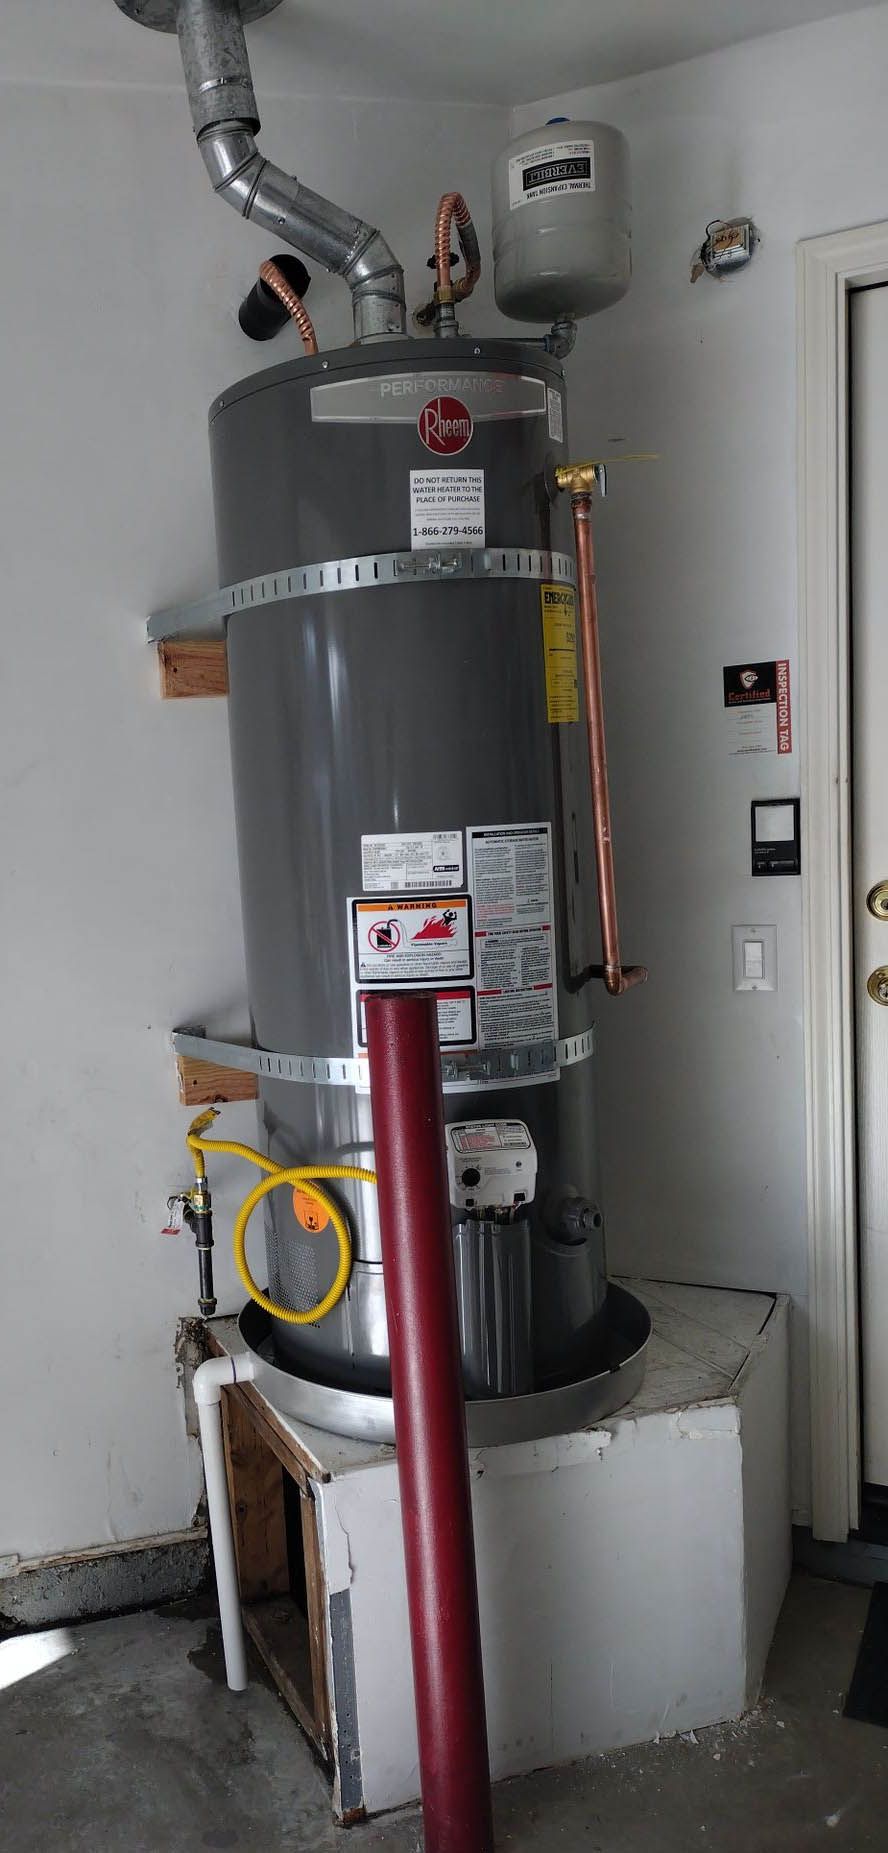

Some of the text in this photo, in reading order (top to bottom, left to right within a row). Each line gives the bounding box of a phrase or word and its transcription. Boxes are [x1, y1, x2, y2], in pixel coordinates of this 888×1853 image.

[528, 163, 585, 183] EVERBILT
[540, 184, 568, 195] EXPANSION
[380, 377, 504, 397] PERFORMANCE
[424, 399, 470, 446] Rheem
[441, 476, 467, 484] RETURN
[447, 495, 481, 503] PURCHASE
[413, 526, 484, 537] 1-866-279-4566
[777, 663, 789, 752] INSPECTION TAG
[396, 902, 437, 910] WARNING
